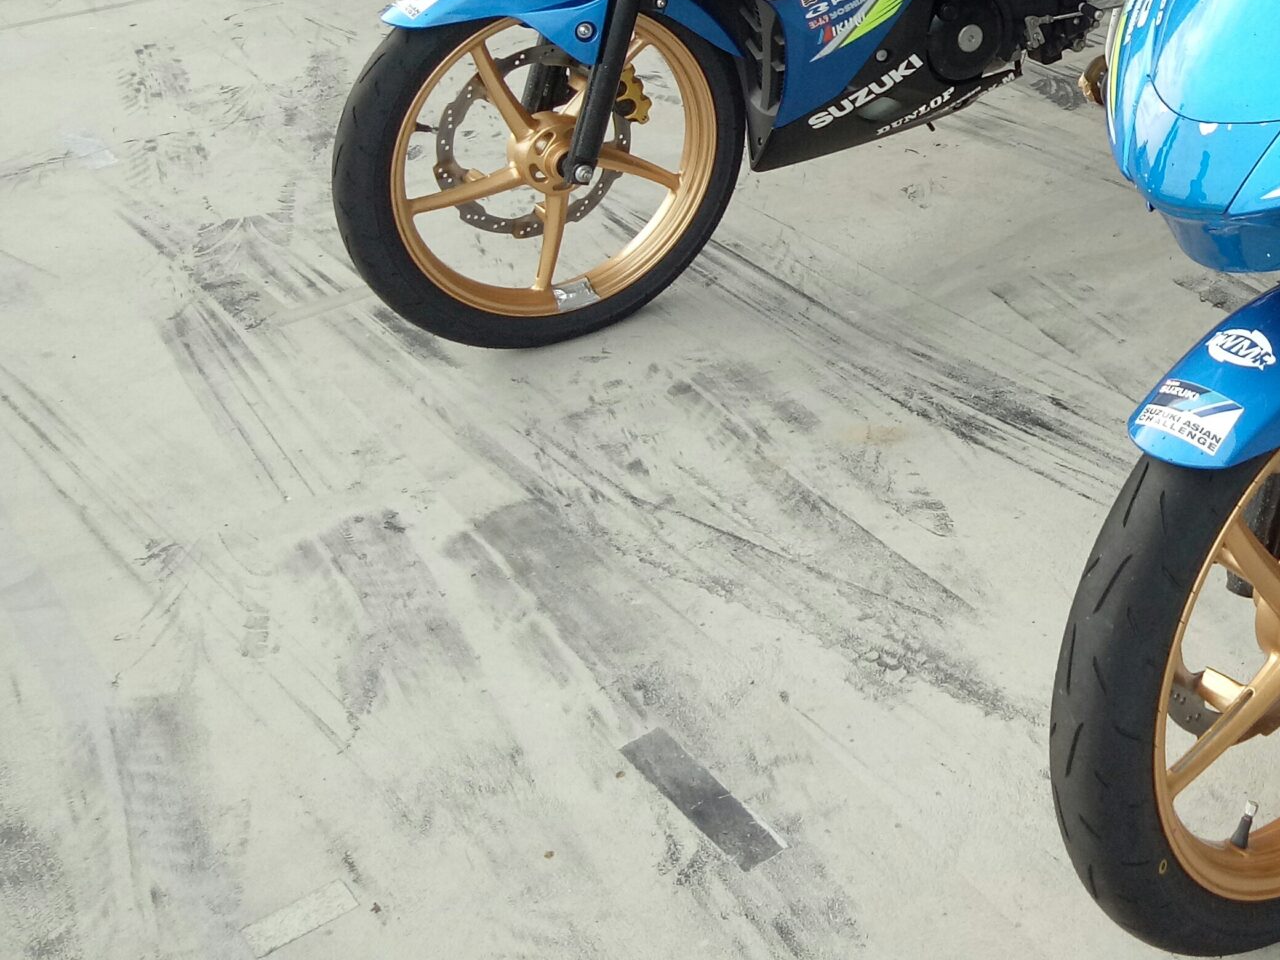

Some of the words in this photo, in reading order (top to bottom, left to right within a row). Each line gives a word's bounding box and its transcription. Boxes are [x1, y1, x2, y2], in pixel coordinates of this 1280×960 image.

[808, 53, 924, 130] SUZUKI
[875, 86, 955, 136] DUNLOP
[1138, 413, 1219, 453] CHALLENGE
[1144, 406, 1181, 424] SUZUKI
[1183, 419, 1222, 445] ASIAN
